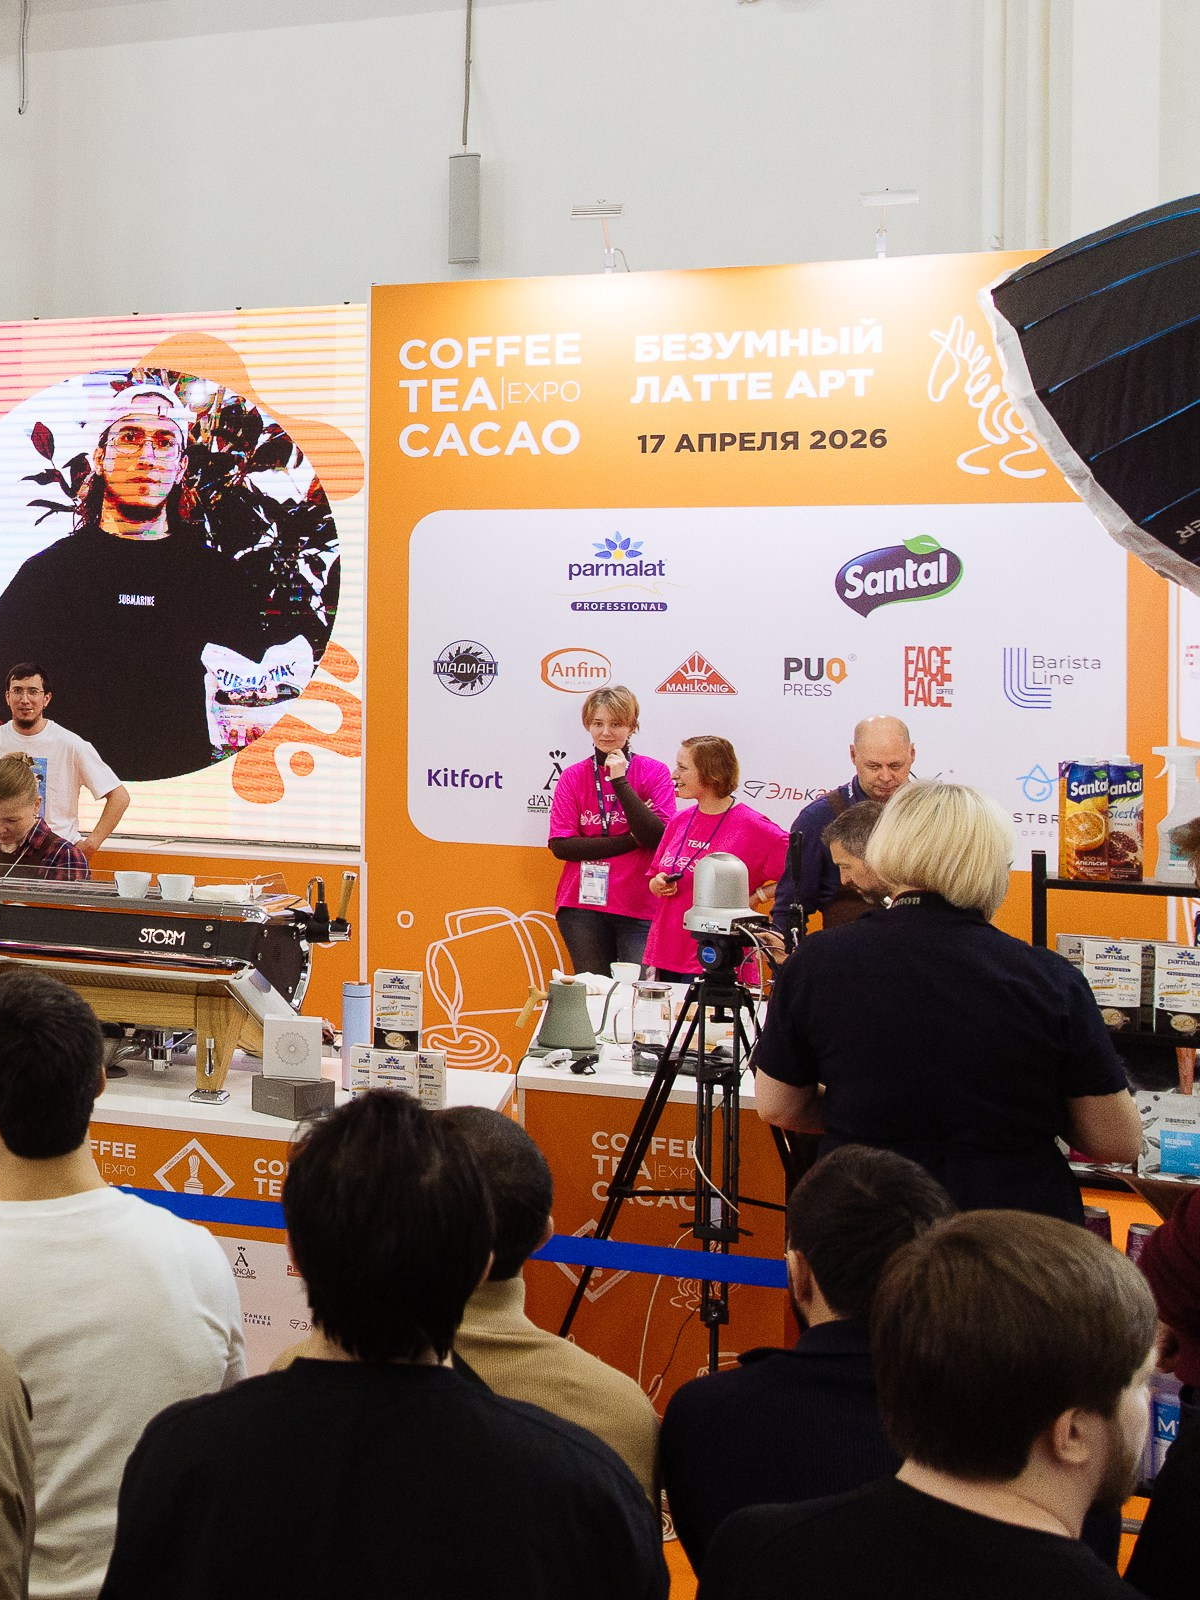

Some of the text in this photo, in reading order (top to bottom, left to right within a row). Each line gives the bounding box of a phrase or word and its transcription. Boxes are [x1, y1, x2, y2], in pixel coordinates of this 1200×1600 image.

[635, 318, 883, 362] БЕЗУМНЫЙ
[399, 333, 582, 370] COFFEE
[630, 368, 874, 404] ЛАТТЕ АРТ
[399, 377, 580, 413] TEA EXPO
[399, 419, 580, 458] CACAO
[637, 428, 888, 453] 17 АПРЕЛЯ 2026
[568, 560, 666, 580] parmalat
[844, 553, 948, 599] Santal
[118, 594, 155, 607] SUBMARINE
[576, 602, 664, 611] PROFESSIONAL
[436, 662, 495, 674] МАДИАН
[551, 662, 607, 678] Anfim
[904, 646, 952, 680] FACE
[1032, 655, 1101, 671] Barista
[666, 680, 730, 693] MAHLKÖNIG
[1032, 672, 1074, 686] Line
[783, 683, 833, 697] PRESS
[427, 767, 503, 790] Kitfort
[1109, 779, 1142, 794] antal
[138, 928, 186, 946] STORM
[1095, 953, 1130, 961] parmalat
[104, 1162, 136, 1176] EXPO
[253, 1177, 282, 1197] TE
[243, 1312, 271, 1321] YANKEE
[244, 1318, 272, 1327] SIERRA
